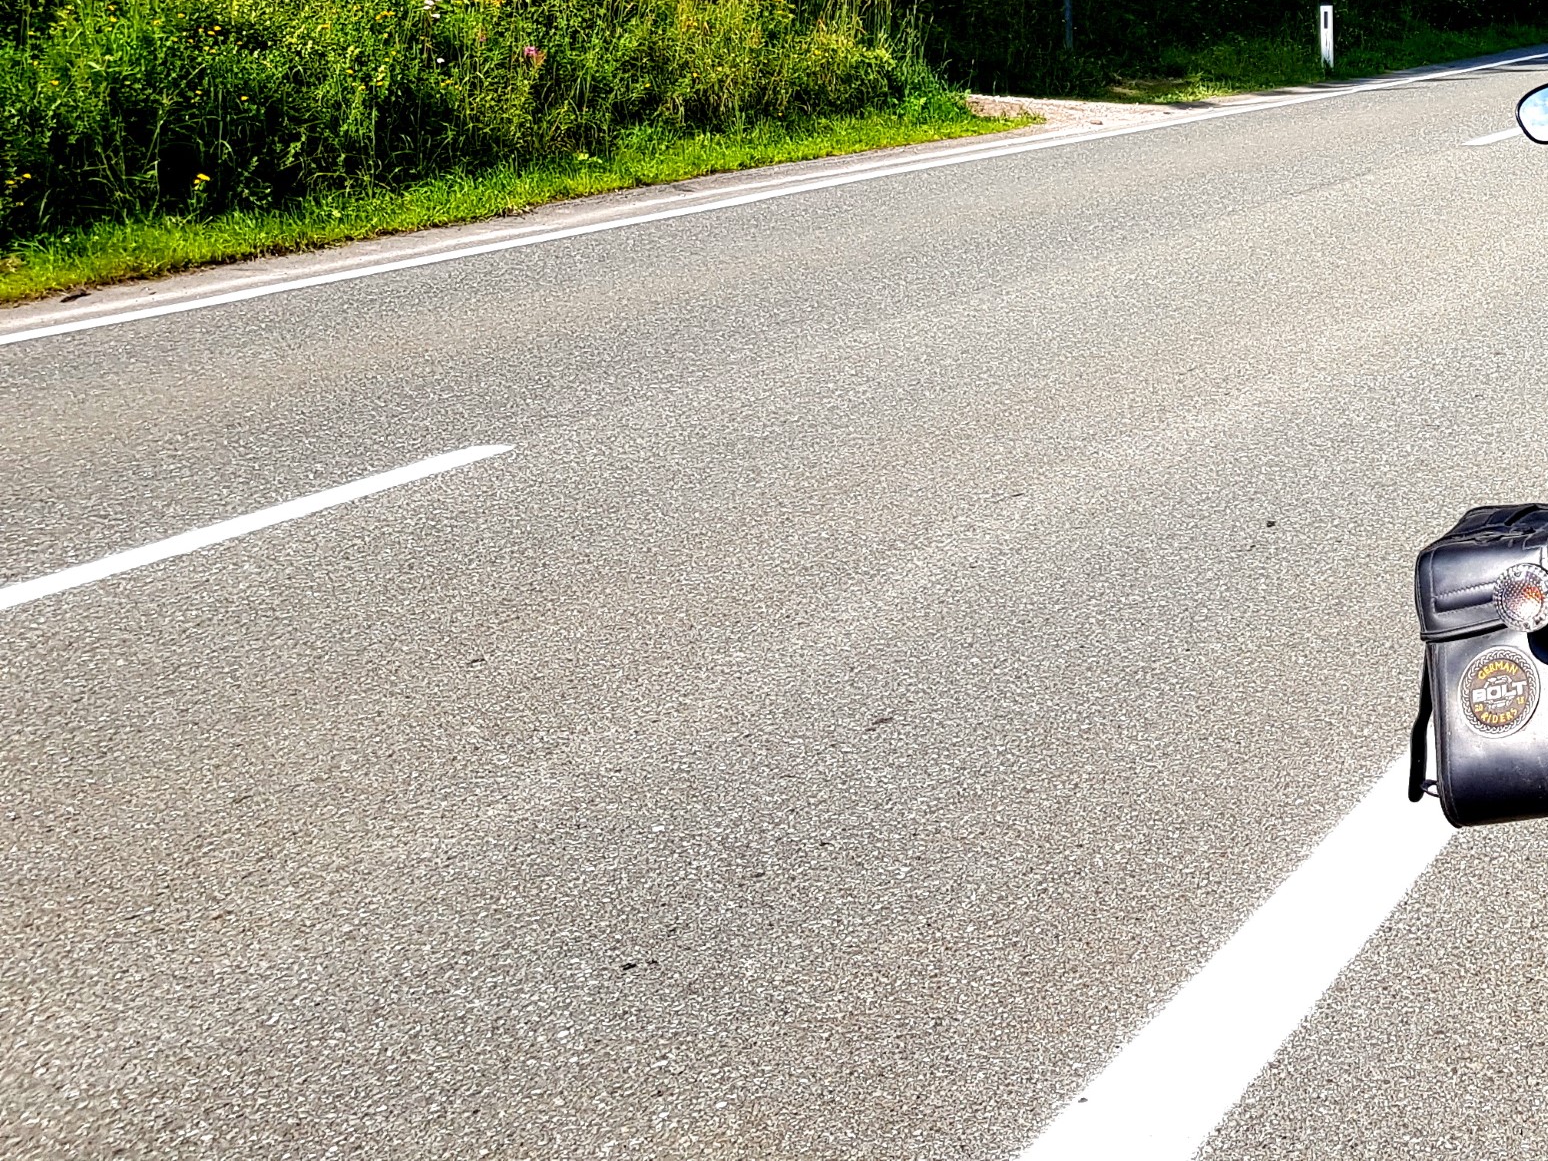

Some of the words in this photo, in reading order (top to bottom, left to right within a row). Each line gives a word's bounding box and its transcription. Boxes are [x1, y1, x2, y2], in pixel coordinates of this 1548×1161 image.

[1477, 660, 1519, 680] GERMAN
[1472, 680, 1528, 703] BOLT
[1480, 707, 1518, 724] RIDERS
